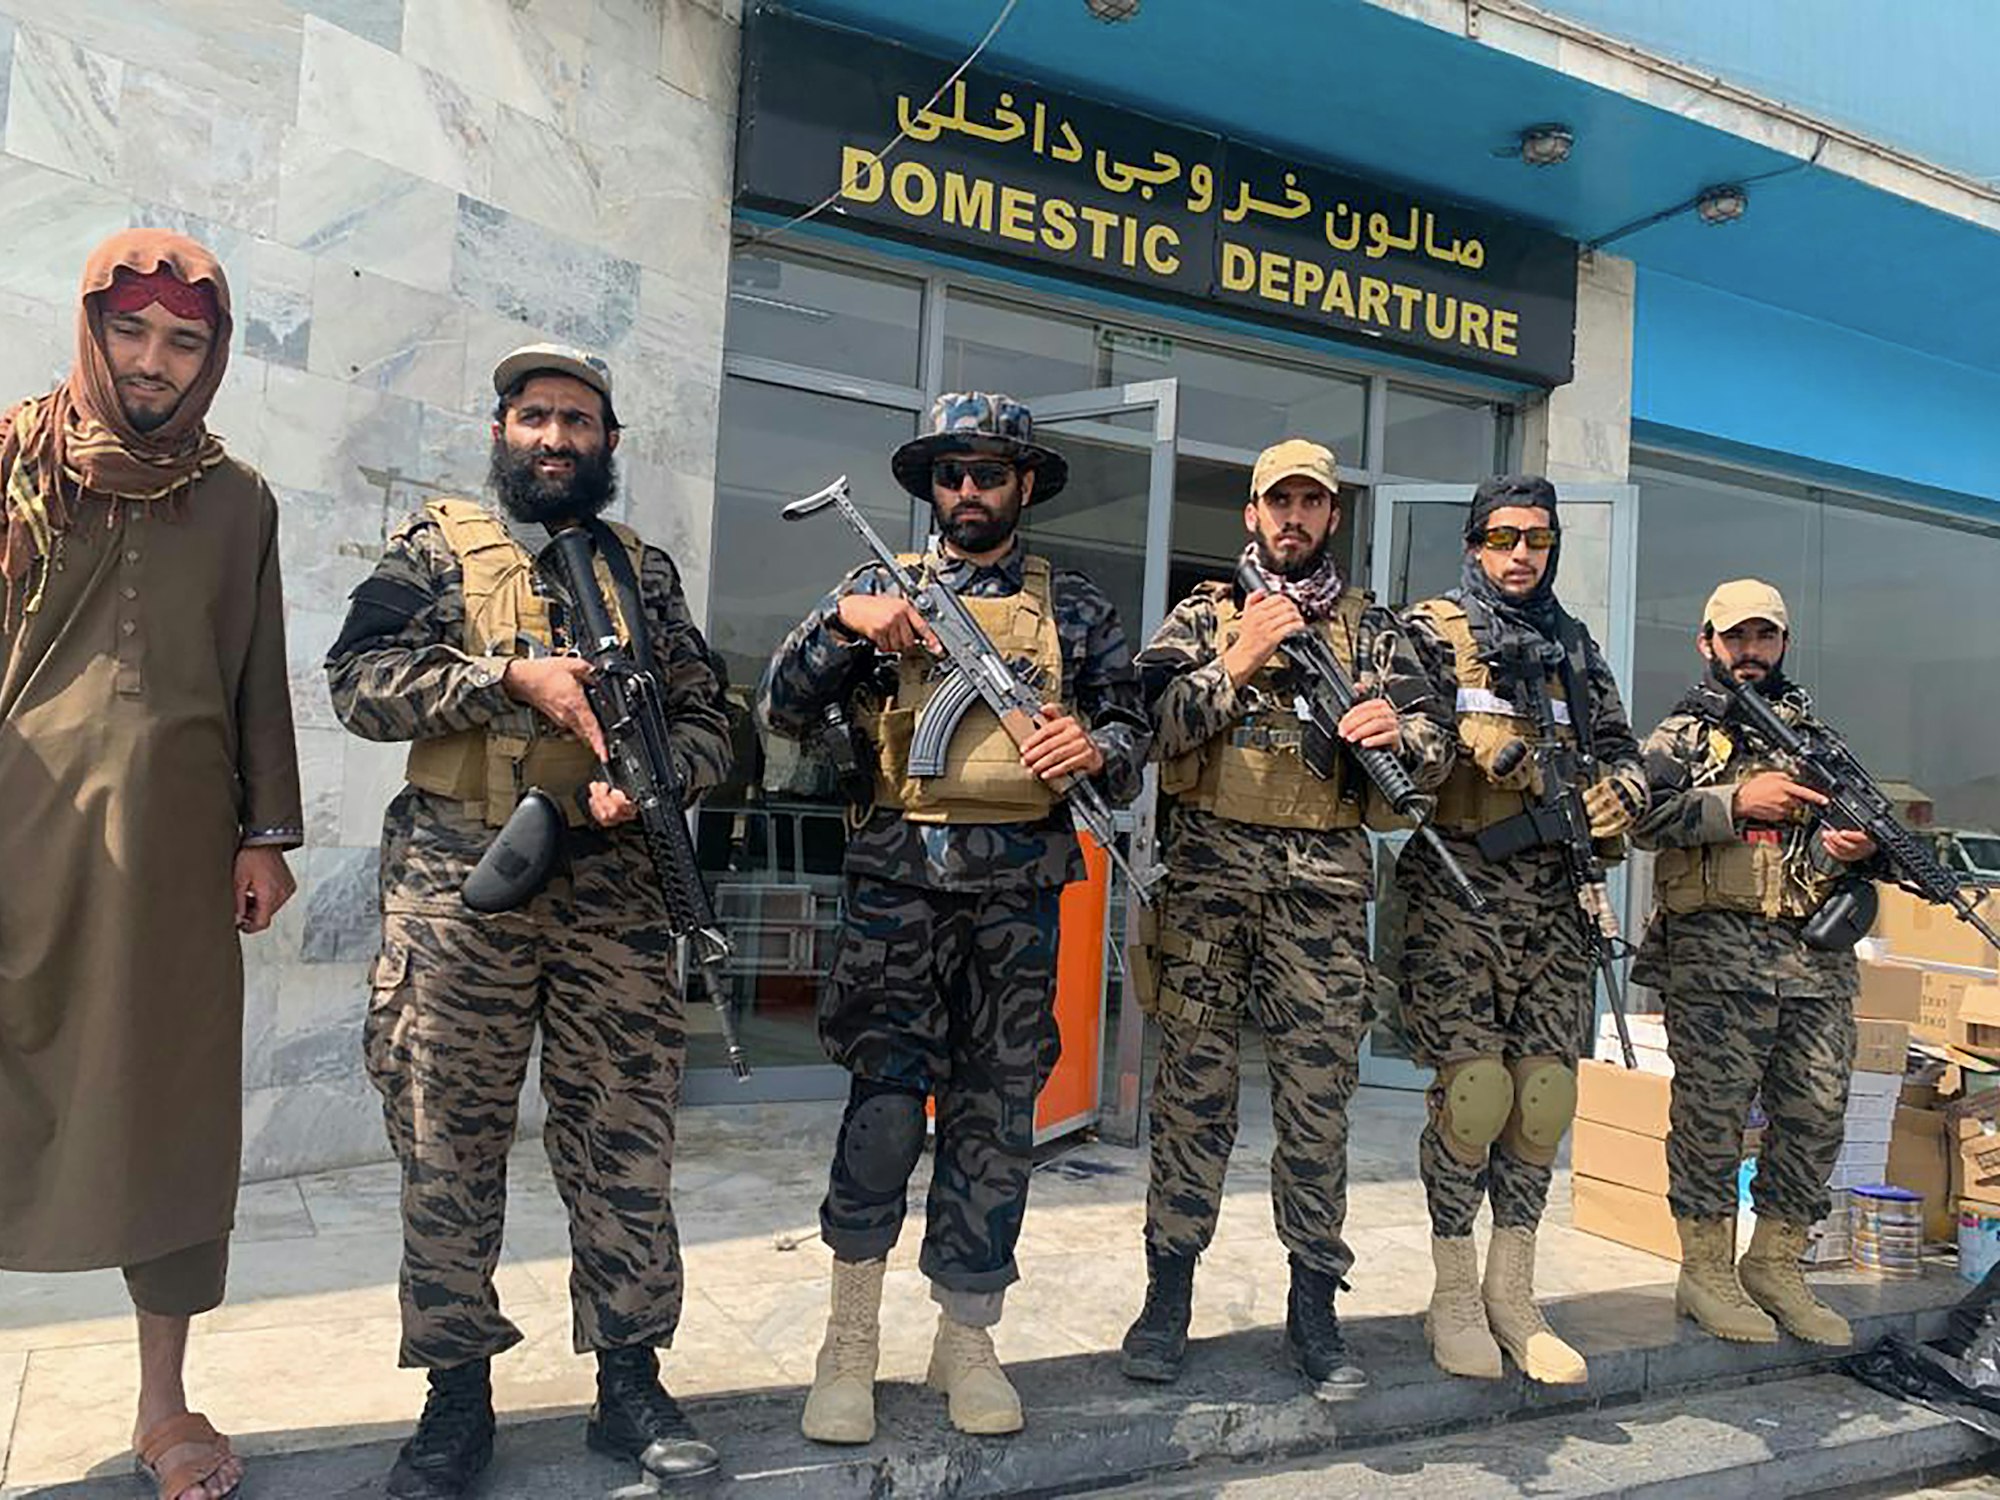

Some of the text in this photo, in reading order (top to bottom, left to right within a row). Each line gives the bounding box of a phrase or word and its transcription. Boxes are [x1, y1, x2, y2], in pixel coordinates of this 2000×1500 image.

[897, 79, 1083, 162] داخلی
[841, 145, 1519, 357] DOMESTIC DEPARTURE
[1325, 203, 1485, 269] صالون
